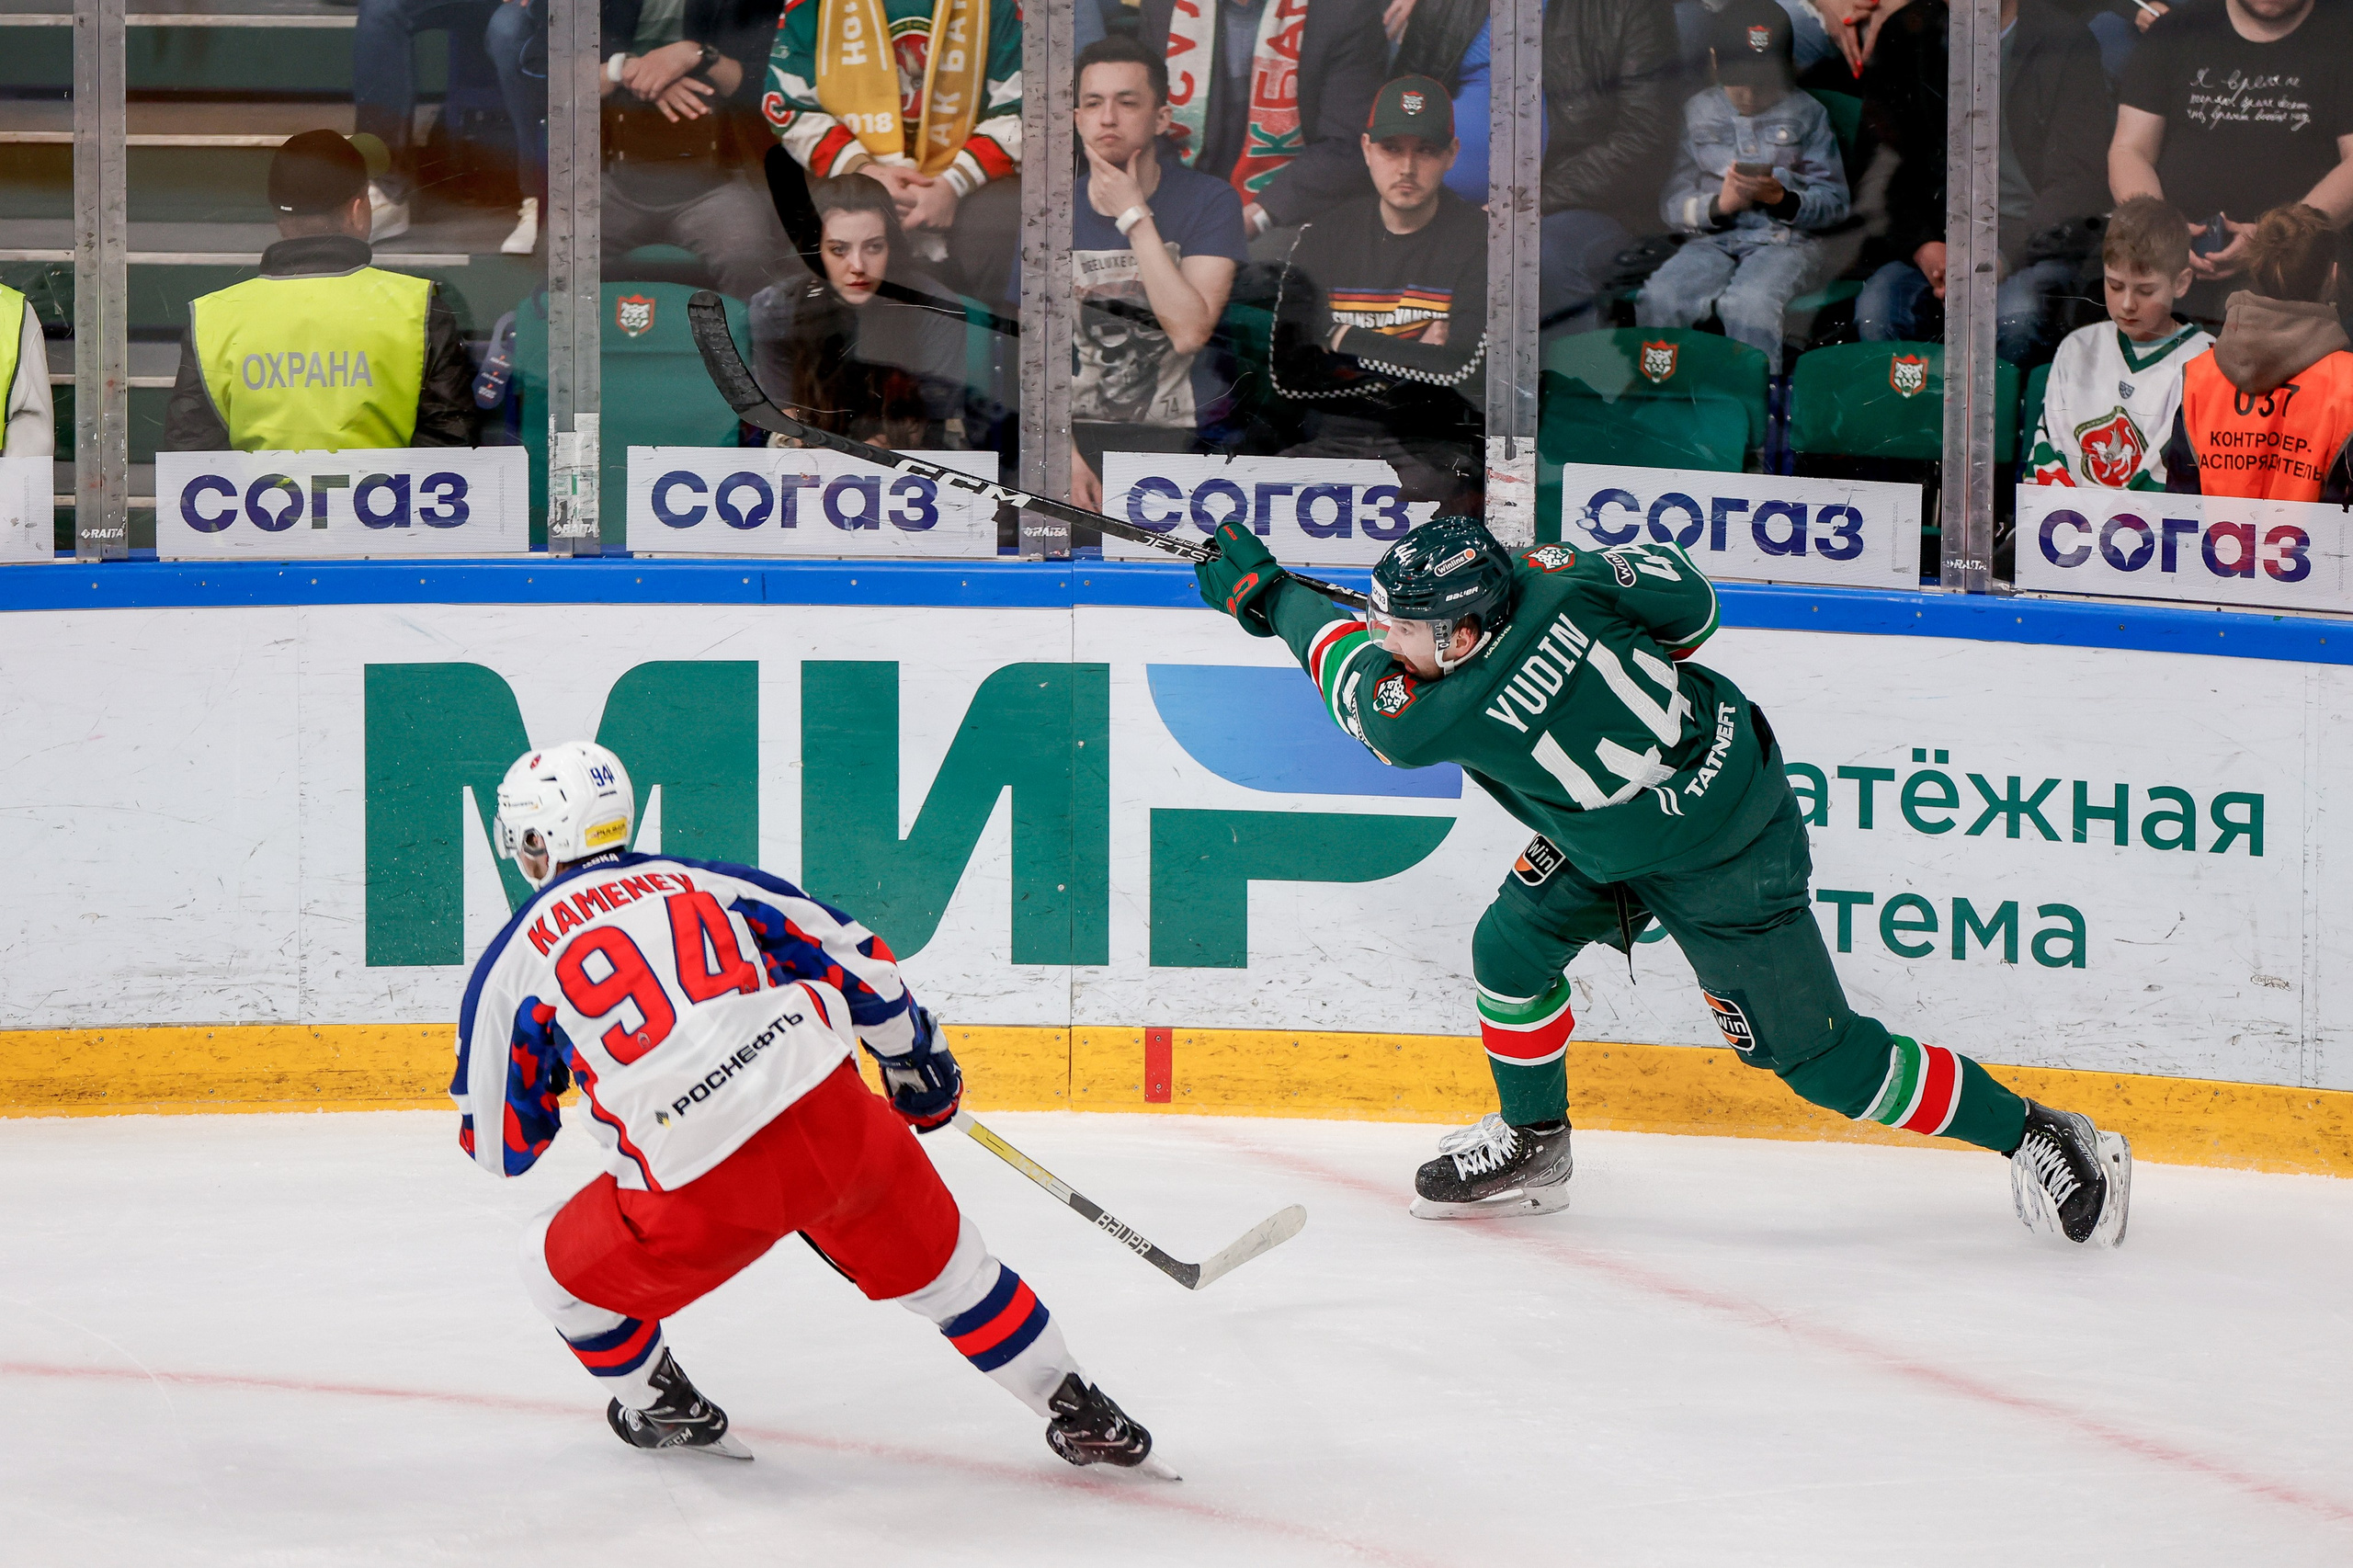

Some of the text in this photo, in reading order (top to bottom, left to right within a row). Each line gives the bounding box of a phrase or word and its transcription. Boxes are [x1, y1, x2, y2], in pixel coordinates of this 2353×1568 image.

[842, 112, 894, 134] 018
[242, 350, 373, 391] ОХРАНА
[2210, 431, 2312, 453] КОНТРОЕР.
[894, 459, 1033, 508] CCM
[91, 528, 124, 539] RAITA
[1437, 555, 1466, 575] Winline
[1485, 612, 1590, 733] YUDIN
[1530, 639, 1695, 811] 44
[1684, 701, 1736, 798] TATNEFT
[589, 762, 616, 788] 94
[1784, 747, 2265, 857] атёжная
[364, 660, 1463, 969] МИР
[1528, 837, 1555, 871] Win
[528, 872, 696, 957] KAMENEV
[1815, 888, 2086, 969] тема
[554, 891, 760, 1066] 94
[672, 1014, 804, 1117] РОСНЕФТЬ
[1095, 1211, 1153, 1256] BAUER
